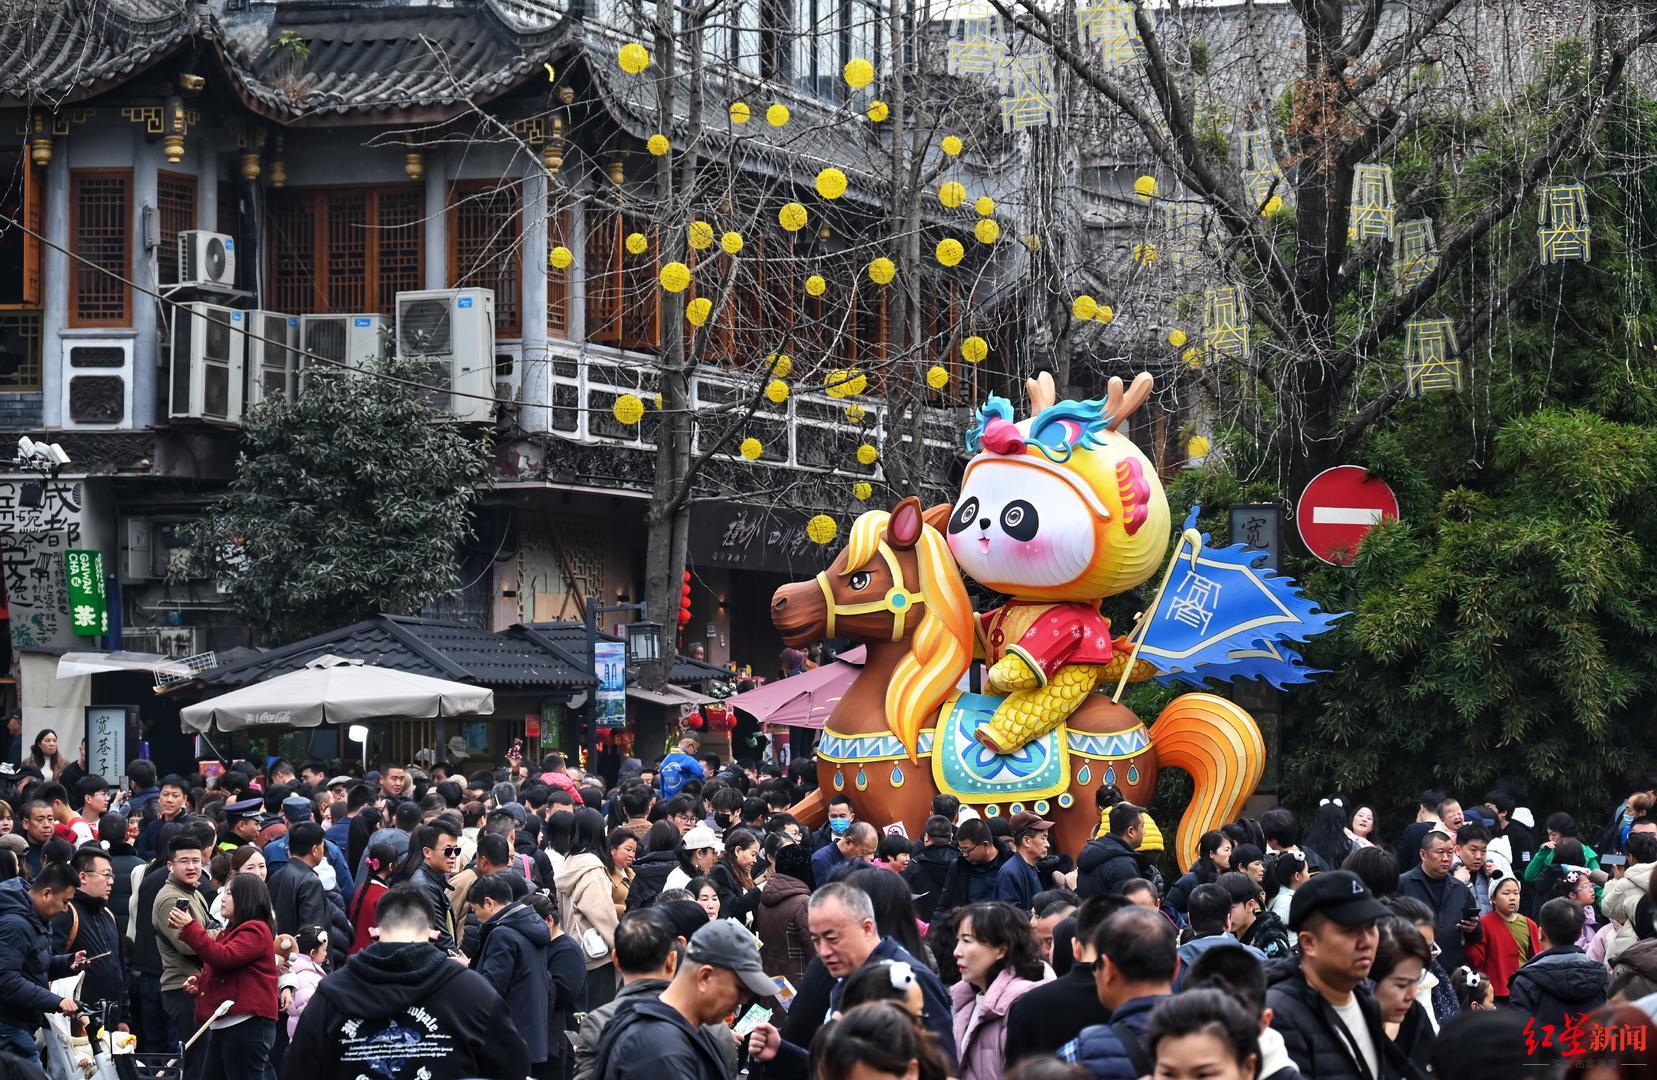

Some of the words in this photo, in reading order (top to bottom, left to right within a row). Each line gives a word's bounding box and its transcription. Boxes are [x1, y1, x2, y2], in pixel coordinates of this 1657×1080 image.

[69, 553, 79, 575] CHA
[79, 553, 93, 594] GAIWAN
[96, 715, 112, 777] 宽巷子
